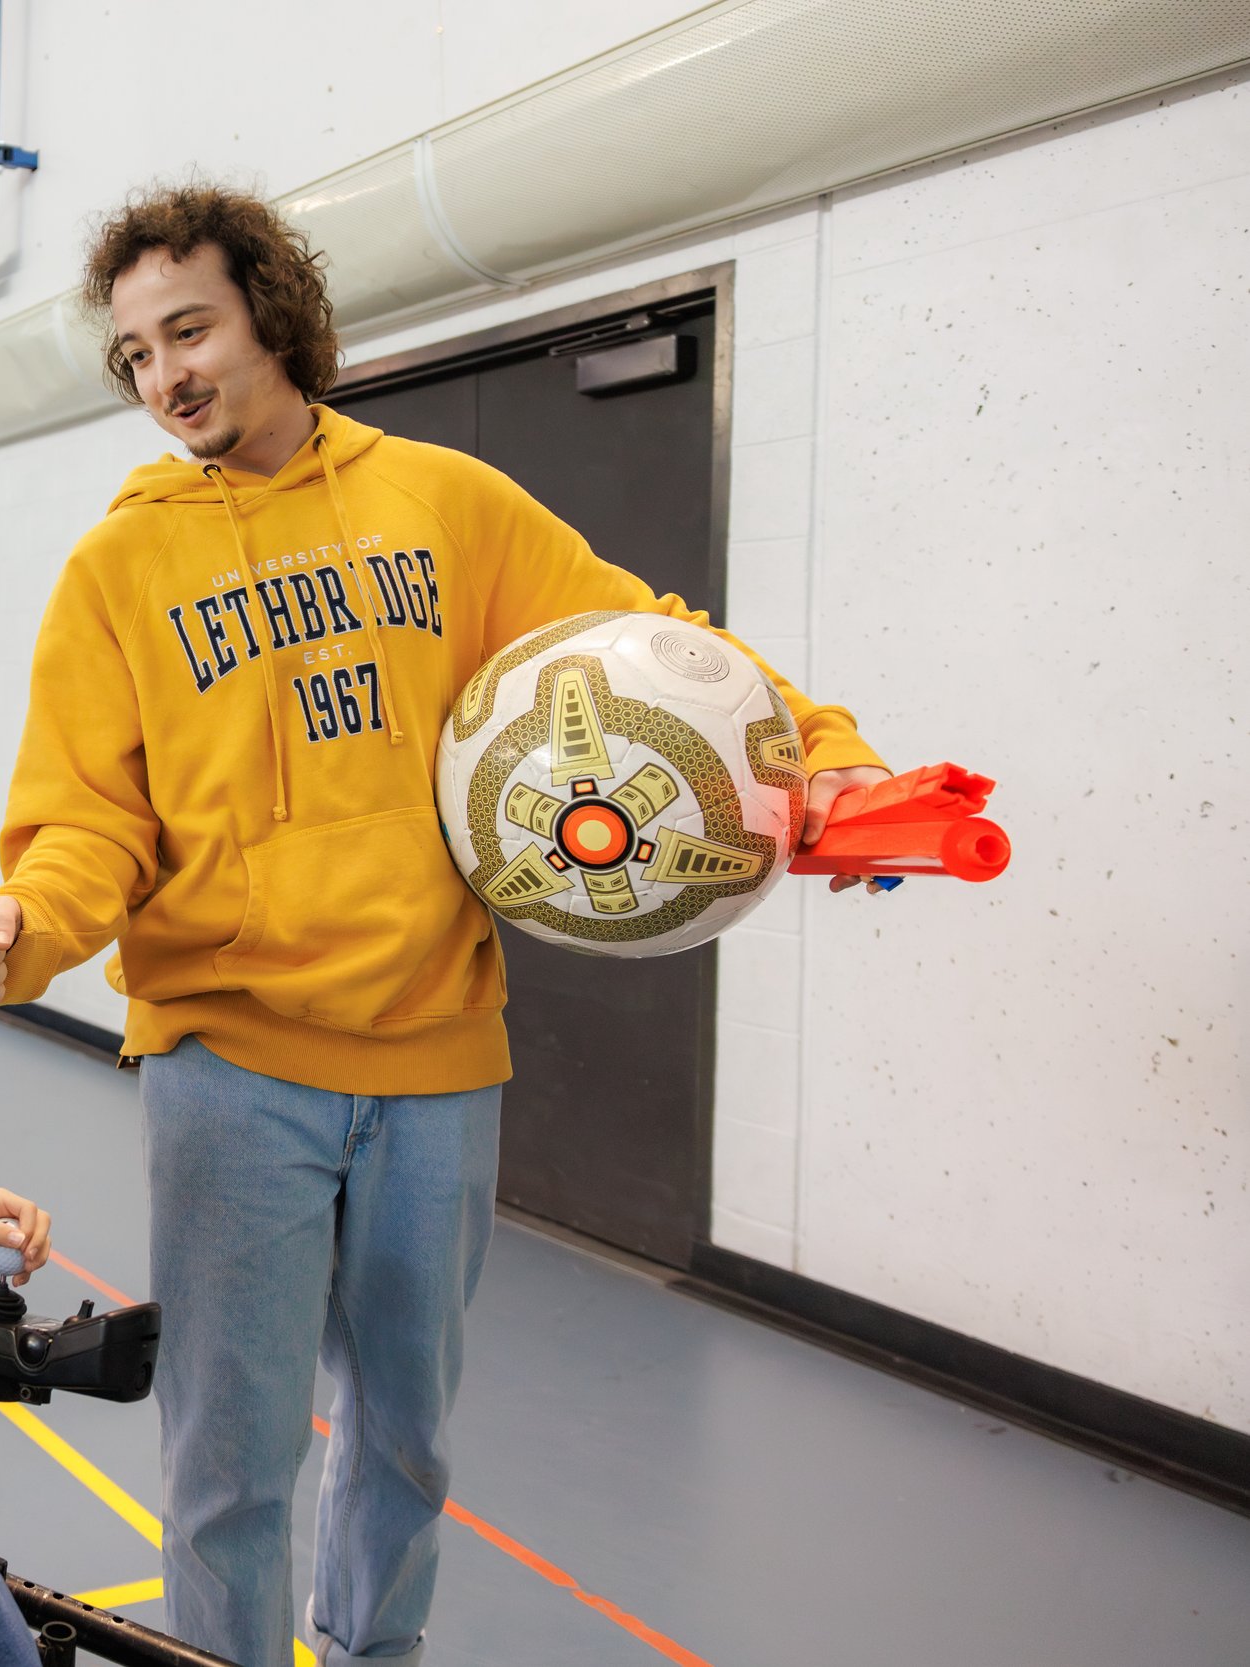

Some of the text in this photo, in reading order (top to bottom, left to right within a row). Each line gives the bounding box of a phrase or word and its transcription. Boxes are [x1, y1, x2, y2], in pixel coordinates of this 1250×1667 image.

[211, 534, 382, 588] UNVERSITY OF
[303, 643, 352, 665] EST.
[292, 661, 384, 742] 1967
